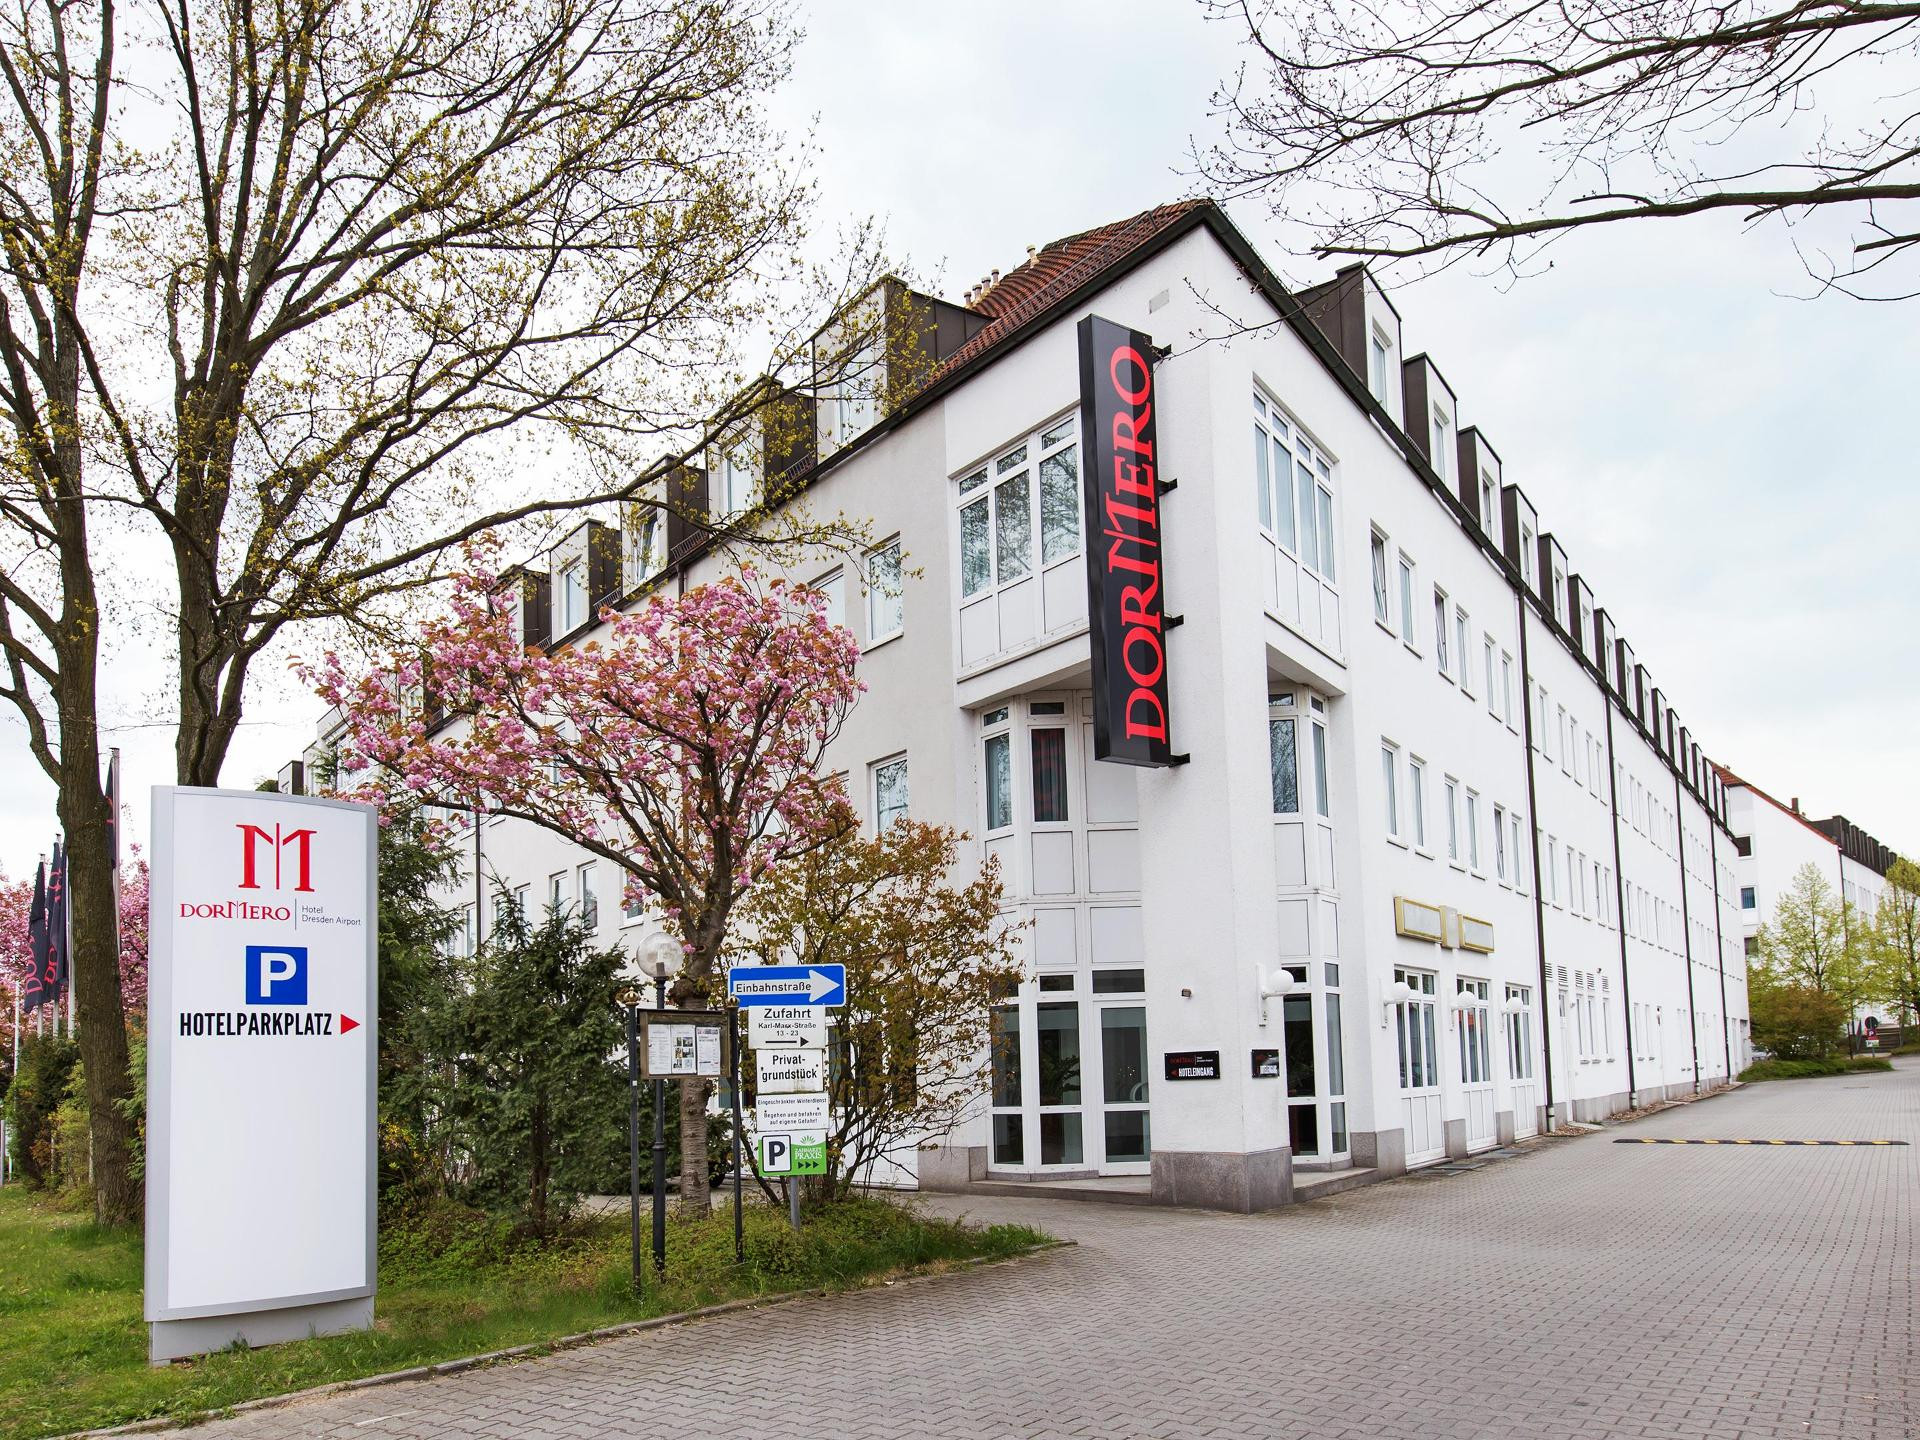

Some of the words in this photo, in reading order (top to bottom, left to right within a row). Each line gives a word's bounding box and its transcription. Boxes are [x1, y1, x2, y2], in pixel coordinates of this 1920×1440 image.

[1104, 345, 1166, 744] DORMERO
[180, 900, 291, 921] DORMERO
[302, 905, 323, 914] Hotel
[302, 915, 334, 924] Dresden
[335, 917, 361, 926] Airport
[260, 952, 297, 998] P
[736, 982, 812, 993] Einbahnstraße
[764, 1008, 811, 1018] Zufahrt
[180, 1012, 332, 1036] HOTELPARKPLATZ
[772, 1054, 806, 1065] Privat-
[762, 1069, 818, 1082] grundstück
[769, 1141, 786, 1166] P
[795, 1152, 823, 1160] PRAXIS
